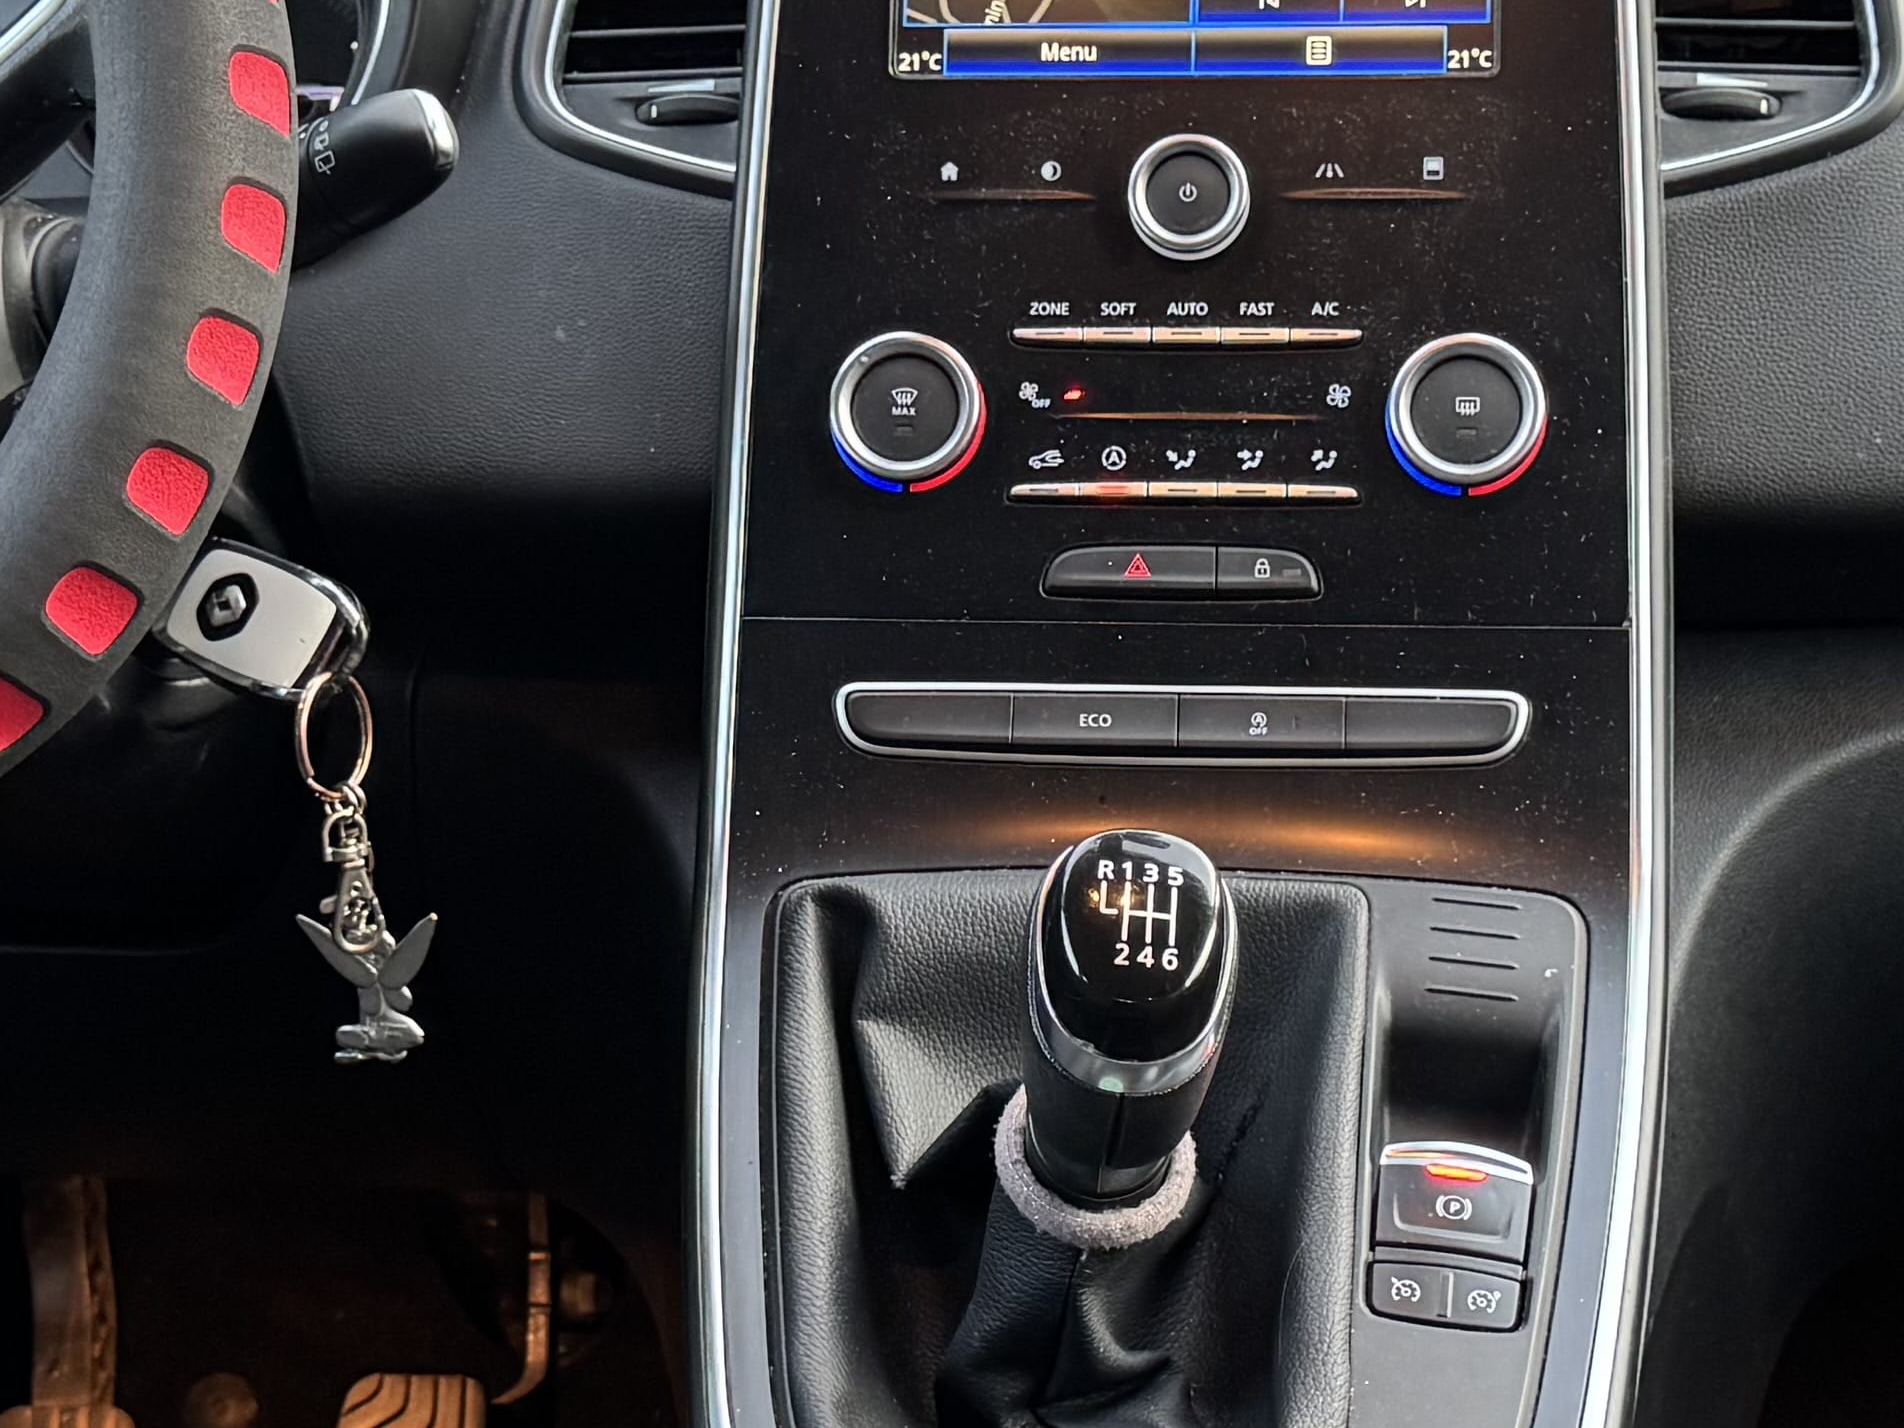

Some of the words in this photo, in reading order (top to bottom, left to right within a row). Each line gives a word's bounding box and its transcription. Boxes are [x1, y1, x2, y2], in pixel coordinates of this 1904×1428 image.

[1040, 42, 1097, 63] Menu
[1447, 48, 1493, 69] 21°C
[898, 51, 943, 72] 21°C
[1029, 302, 1070, 316] ZONE
[1100, 302, 1136, 316] SOFT
[1166, 302, 1208, 316] AUTO
[1239, 302, 1274, 316] FAST
[1311, 301, 1339, 317] A/C
[1032, 398, 1051, 409] OFF
[892, 406, 916, 416] MAX
[1079, 713, 1112, 727] ECO
[1249, 727, 1268, 736] OFF
[1097, 859, 1114, 880] R
[1122, 861, 1132, 881] 1
[1142, 862, 1159, 883] 3
[1168, 866, 1184, 887] 5
[1113, 942, 1130, 966] 2
[1137, 945, 1155, 968] 4
[1162, 948, 1179, 971] 6
